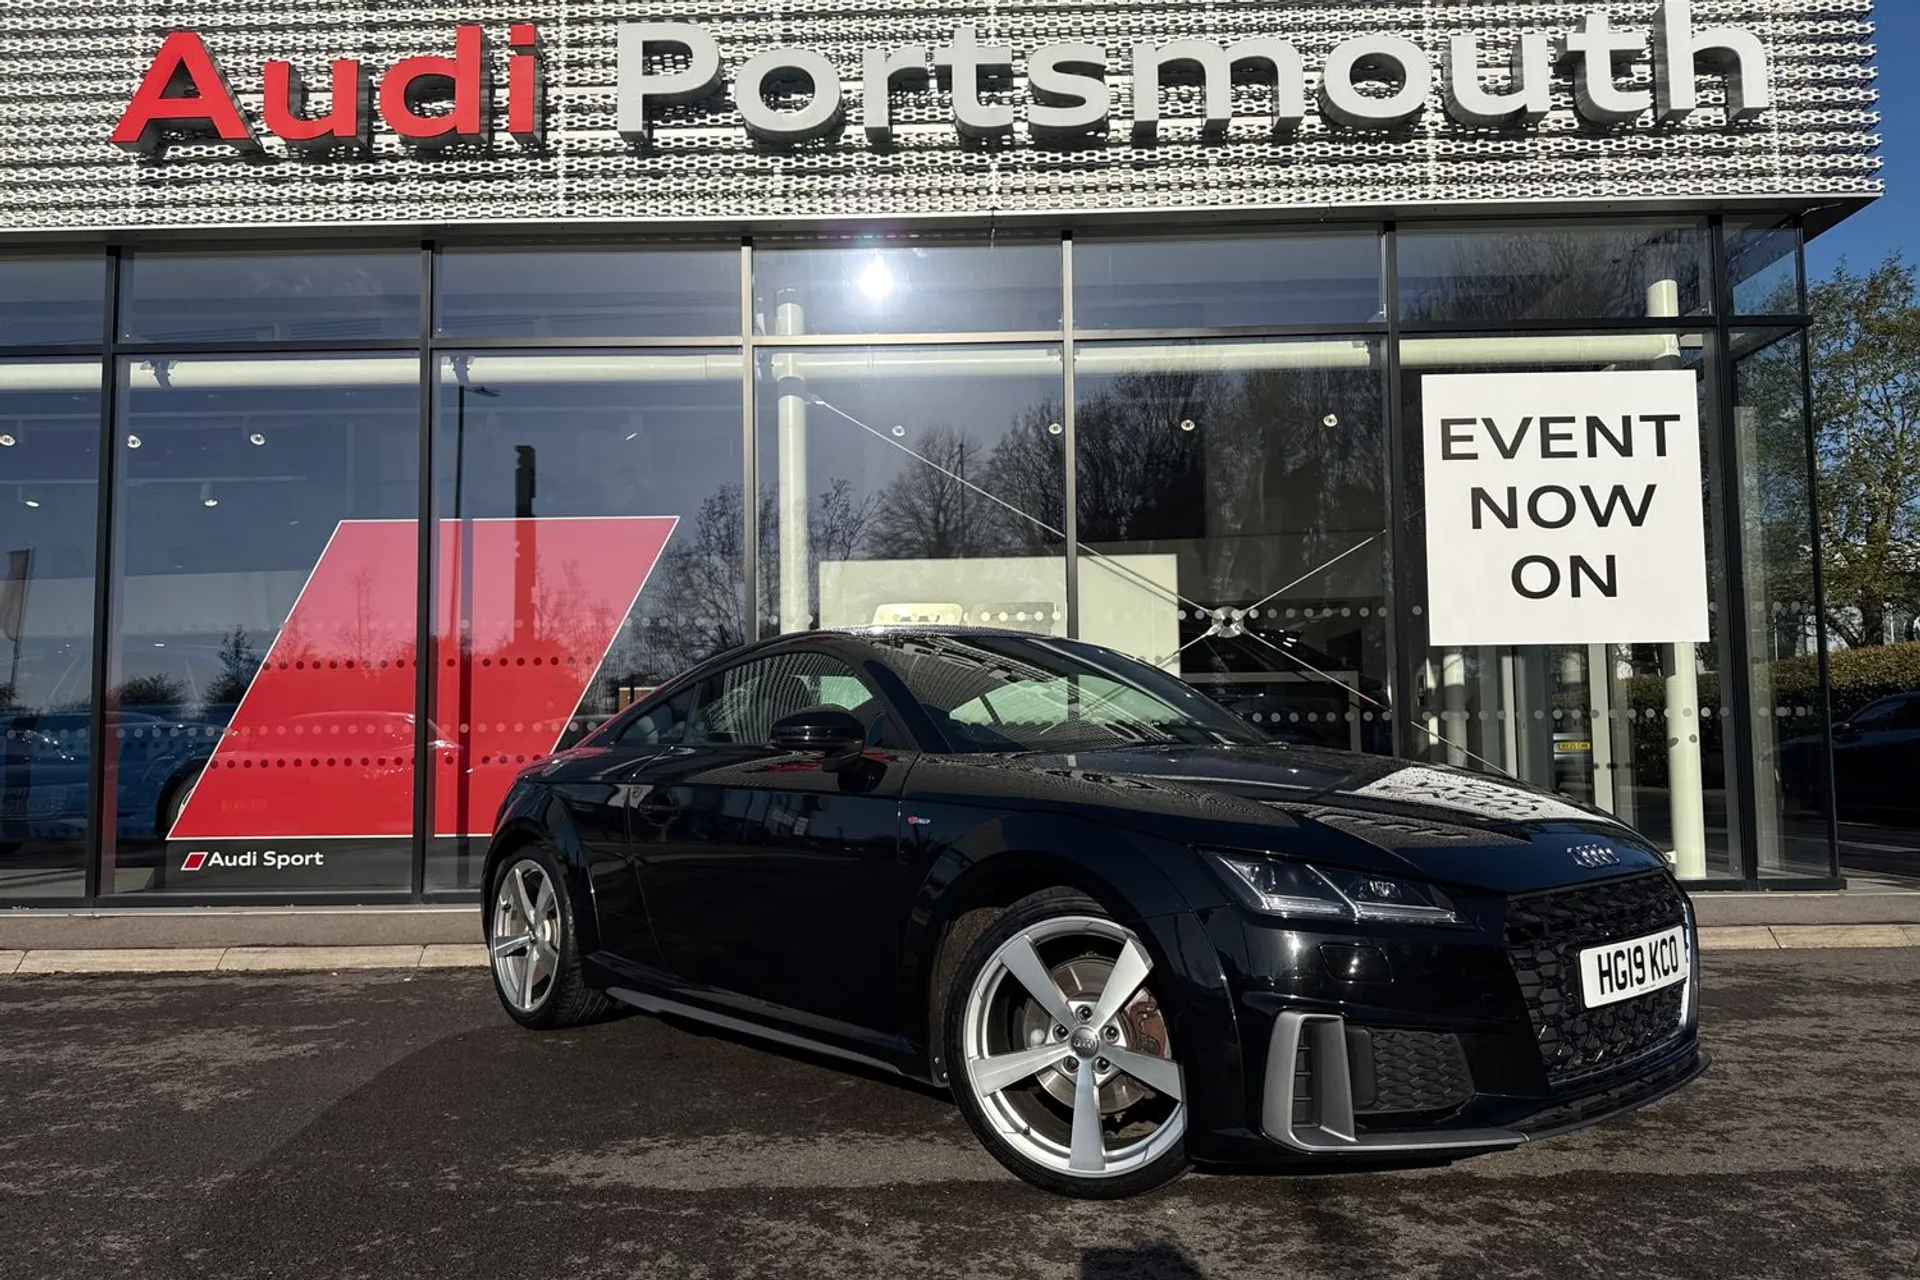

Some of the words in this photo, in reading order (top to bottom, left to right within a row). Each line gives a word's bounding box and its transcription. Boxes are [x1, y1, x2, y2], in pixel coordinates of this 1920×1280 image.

[110, 23, 540, 145] Audi
[617, 0, 1769, 137] Portsmouth
[1440, 414, 1681, 461] EVENT
[1471, 484, 1657, 530] NOW
[1511, 554, 1617, 599] ON
[207, 851, 257, 867] Audi
[263, 851, 324, 870] Sport
[1597, 945, 1646, 995] HG19
[1648, 935, 1679, 981] KCO
